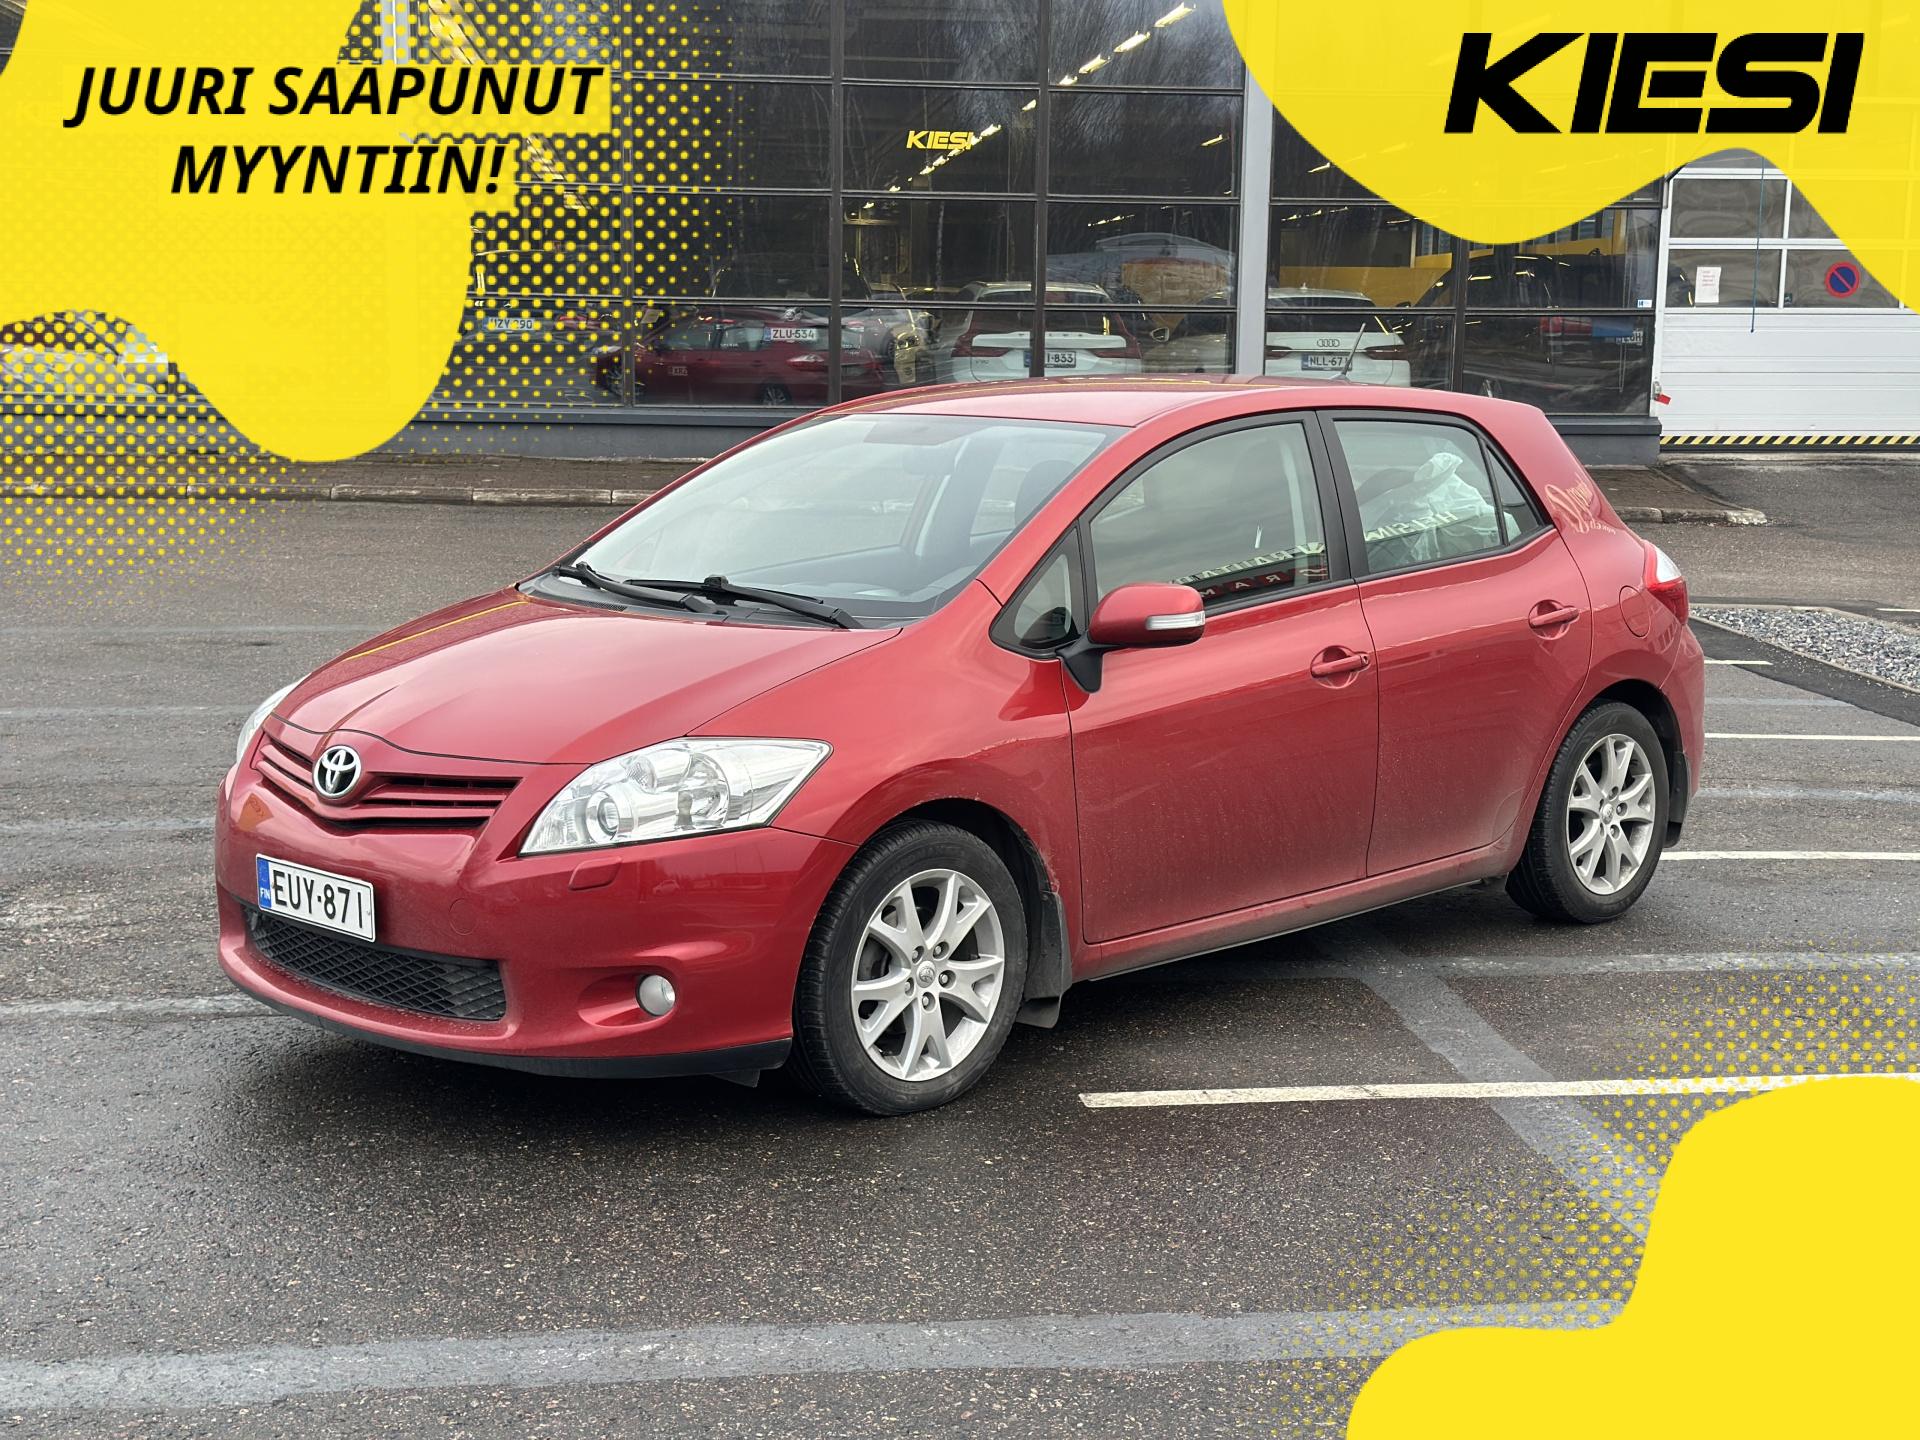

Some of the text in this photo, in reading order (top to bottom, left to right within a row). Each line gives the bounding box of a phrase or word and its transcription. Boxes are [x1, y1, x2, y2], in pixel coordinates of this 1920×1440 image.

[906, 131, 975, 150] KIESI
[773, 329, 814, 339] ZLU-534
[1047, 353, 1073, 363] I-833
[260, 870, 363, 929] FIN EUY-871
